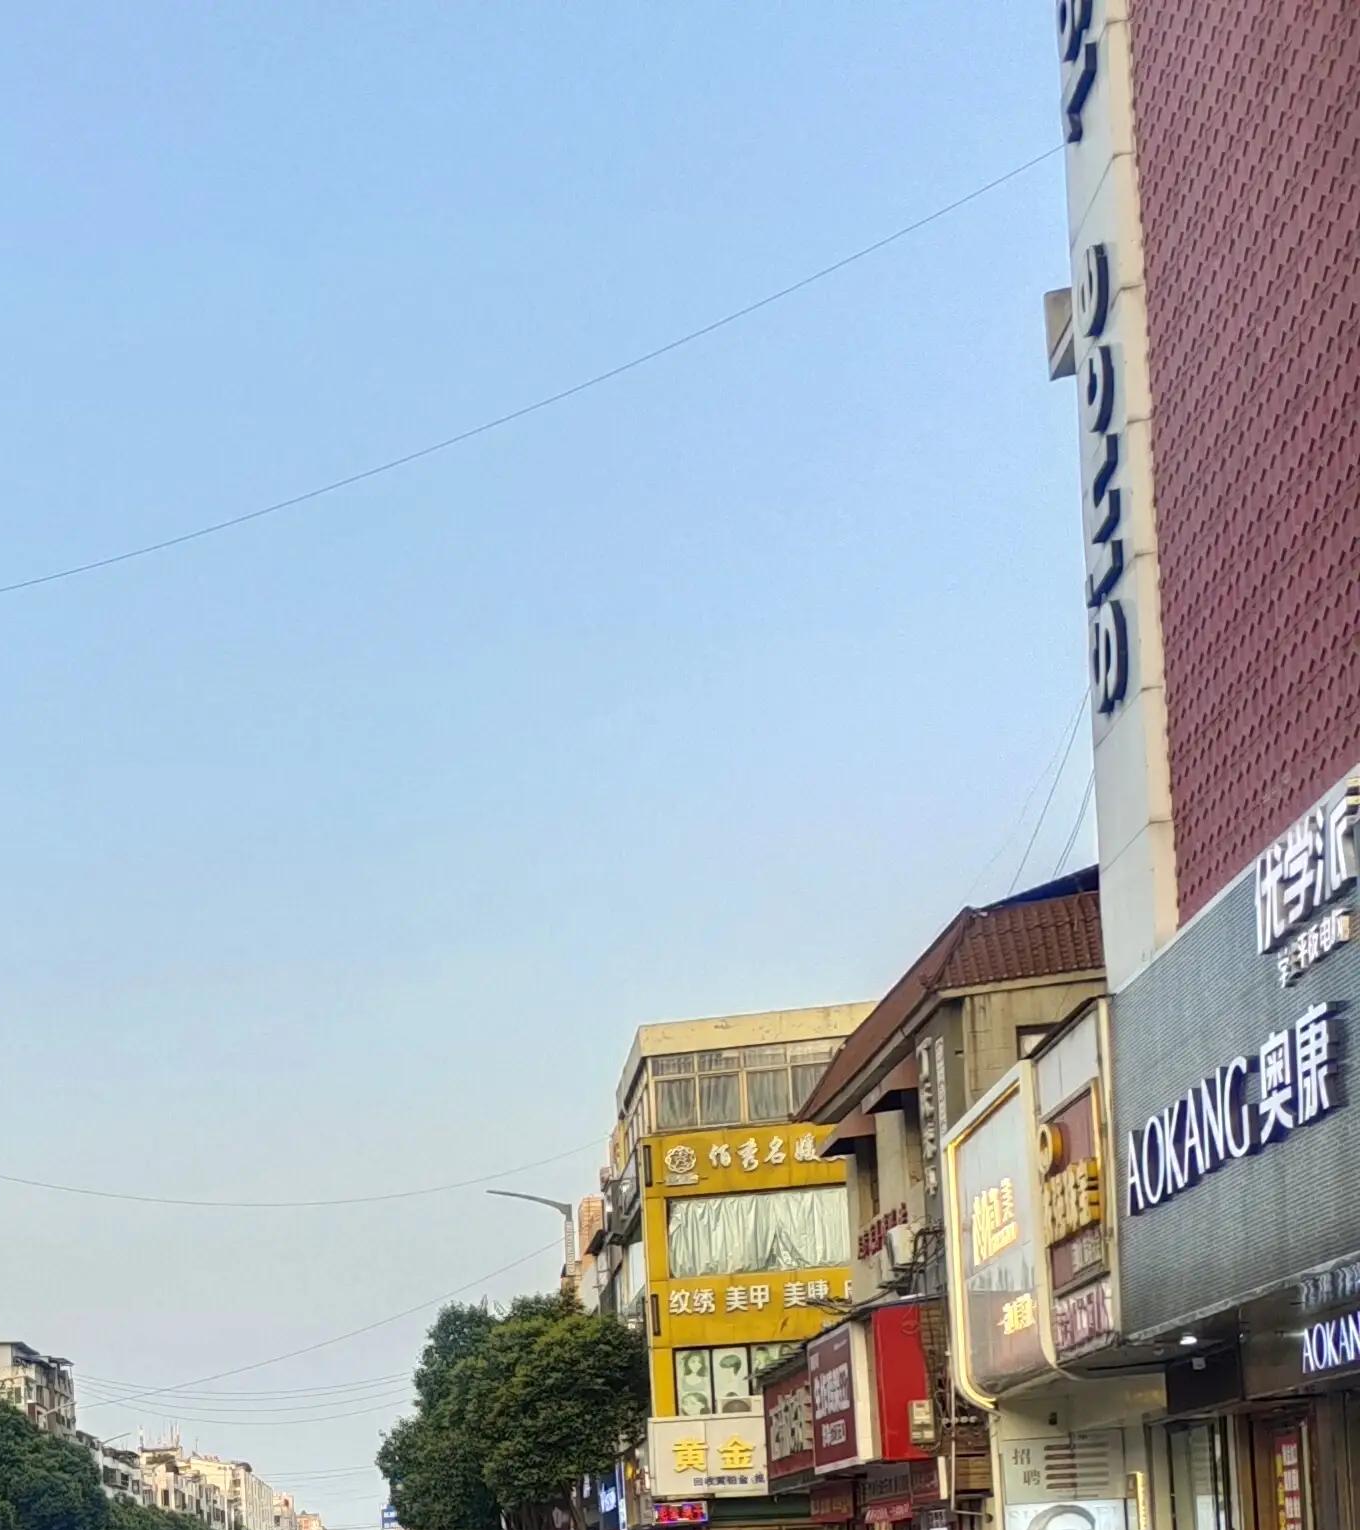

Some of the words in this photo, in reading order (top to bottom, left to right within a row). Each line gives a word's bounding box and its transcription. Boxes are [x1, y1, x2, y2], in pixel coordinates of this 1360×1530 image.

[1127, 1056, 1251, 1217] AOKANG
[1258, 1001, 1330, 1144] 奥康
[669, 1287, 717, 1316] 纹绣
[725, 1284, 771, 1313] 美甲
[671, 1432, 757, 1474] 黄金
